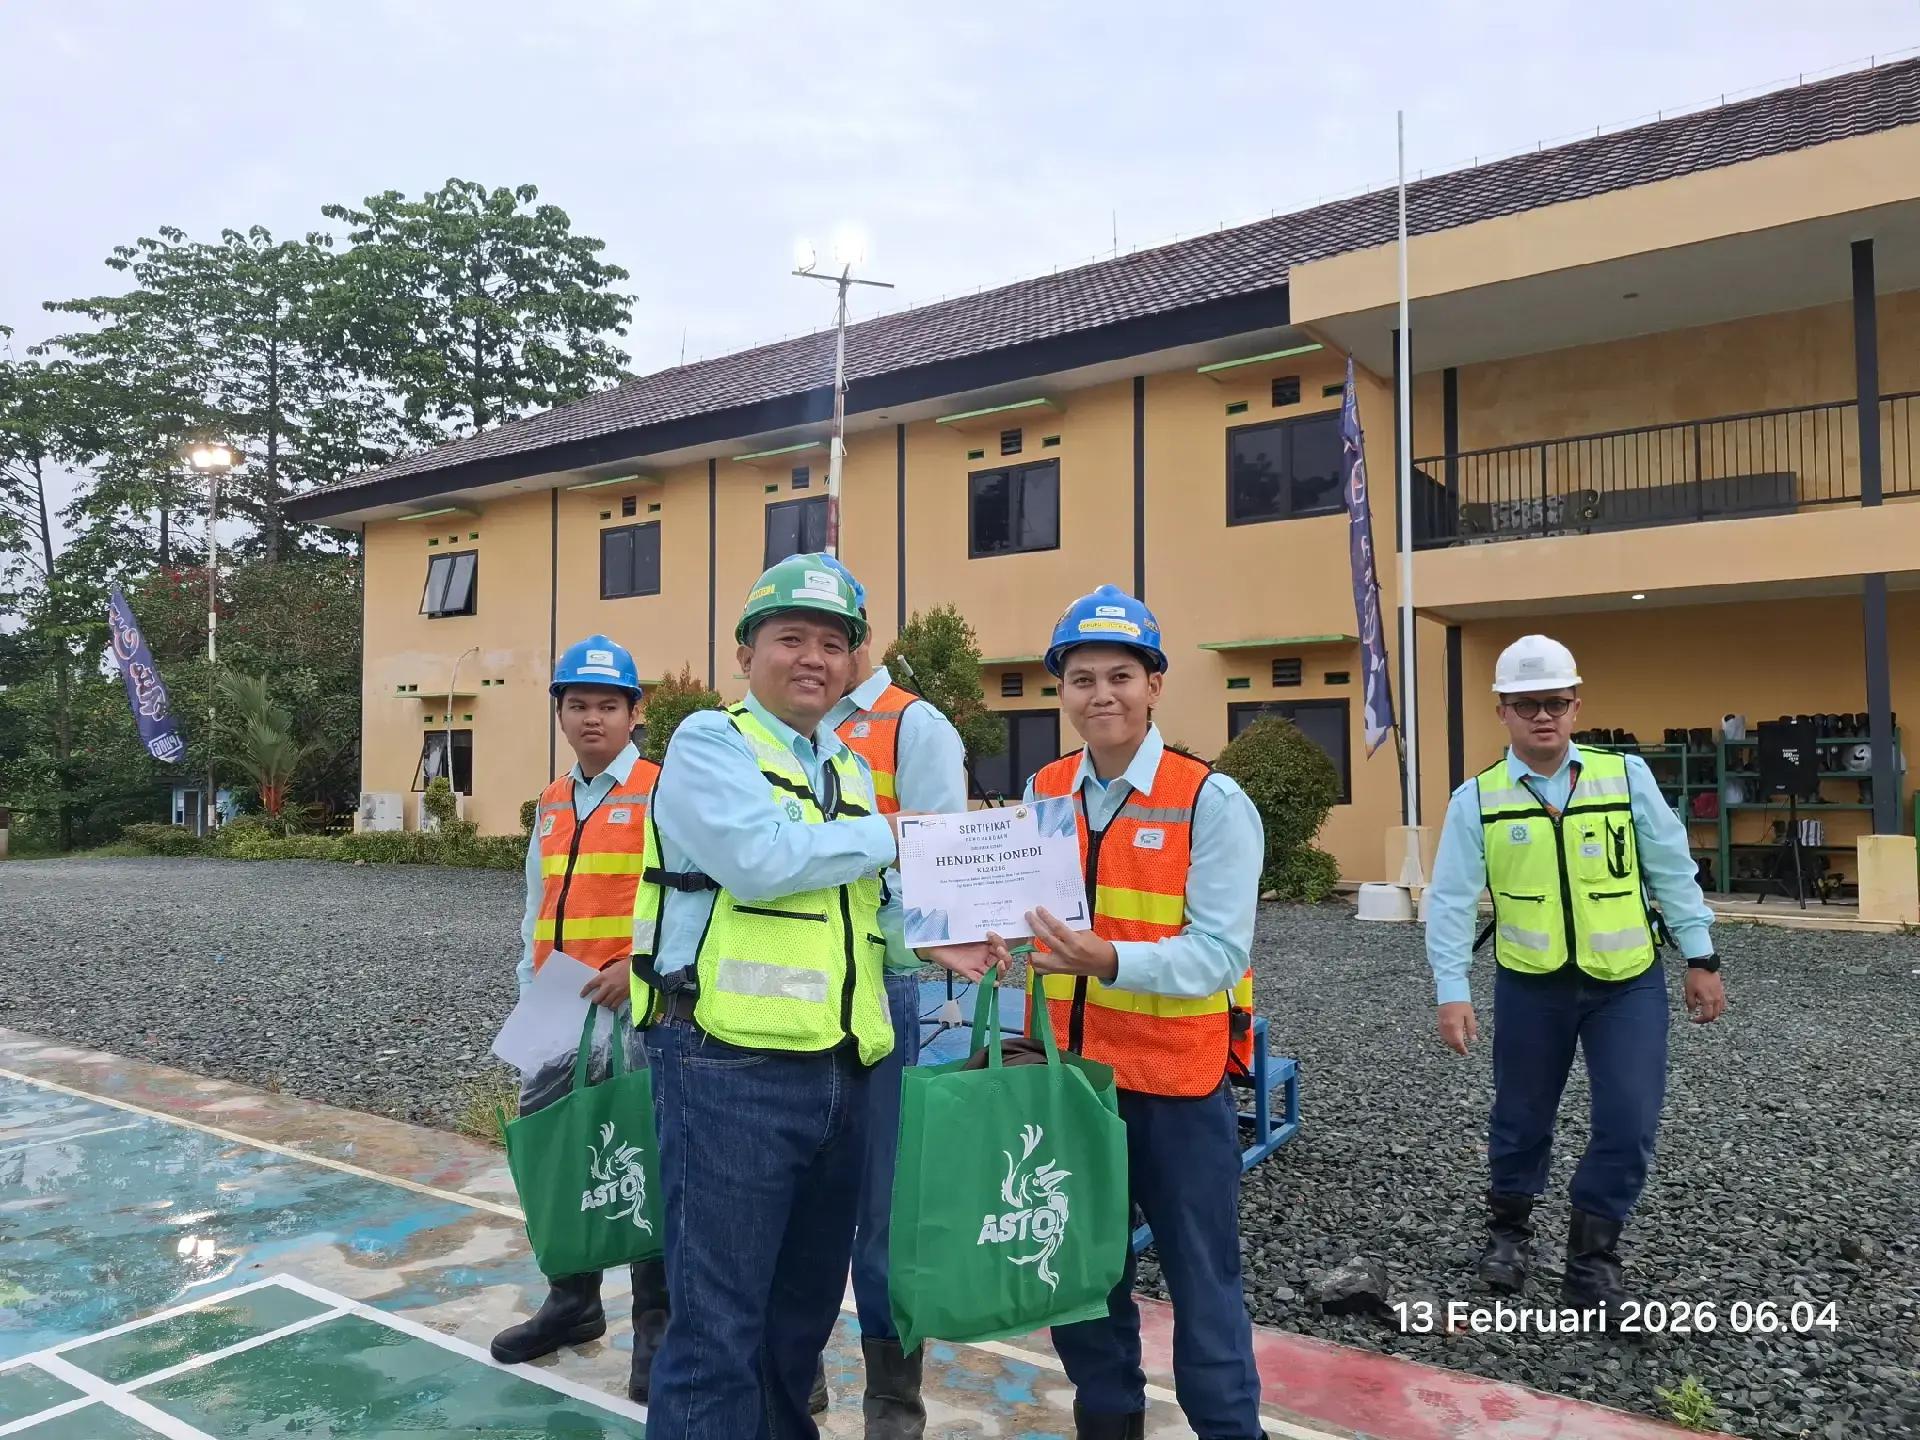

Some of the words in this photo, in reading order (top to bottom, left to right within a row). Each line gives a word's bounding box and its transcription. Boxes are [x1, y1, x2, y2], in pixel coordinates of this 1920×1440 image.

[959, 820, 1011, 835] SERTIFIKAT
[936, 854, 995, 866] HENDRIK
[999, 846, 1043, 862] JONEDI
